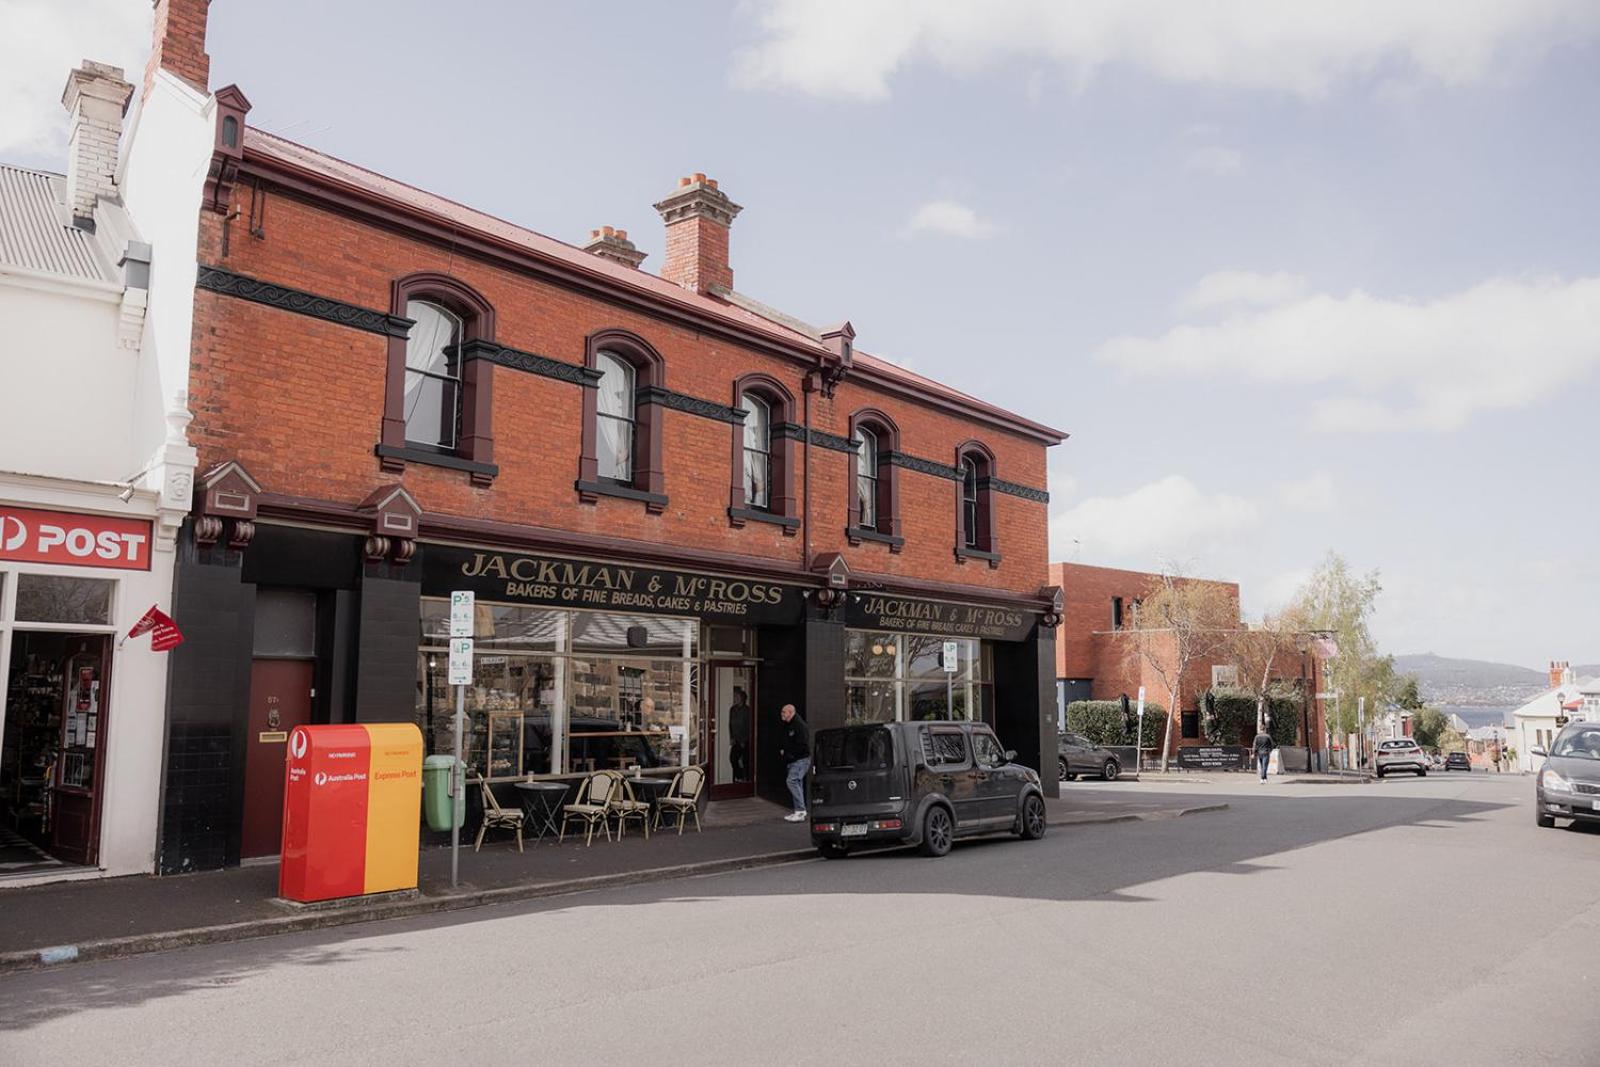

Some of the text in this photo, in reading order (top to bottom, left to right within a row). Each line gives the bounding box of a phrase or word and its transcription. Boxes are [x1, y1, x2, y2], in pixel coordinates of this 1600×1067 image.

[38, 525, 145, 560] POST
[461, 553, 634, 590] JACKMAN
[648, 575, 663, 592] &
[506, 582, 557, 599] BAKERS
[562, 587, 578, 600] OF
[582, 589, 607, 603] FINE
[657, 596, 690, 610] CAKES
[694, 602, 701, 611] &
[704, 600, 747, 614] PASTRIES
[864, 598, 942, 619] JACKMAN
[950, 609, 957, 622] &
[879, 616, 904, 627] BAKERS
[906, 619, 916, 628] OF
[375, 771, 401, 780] Express
